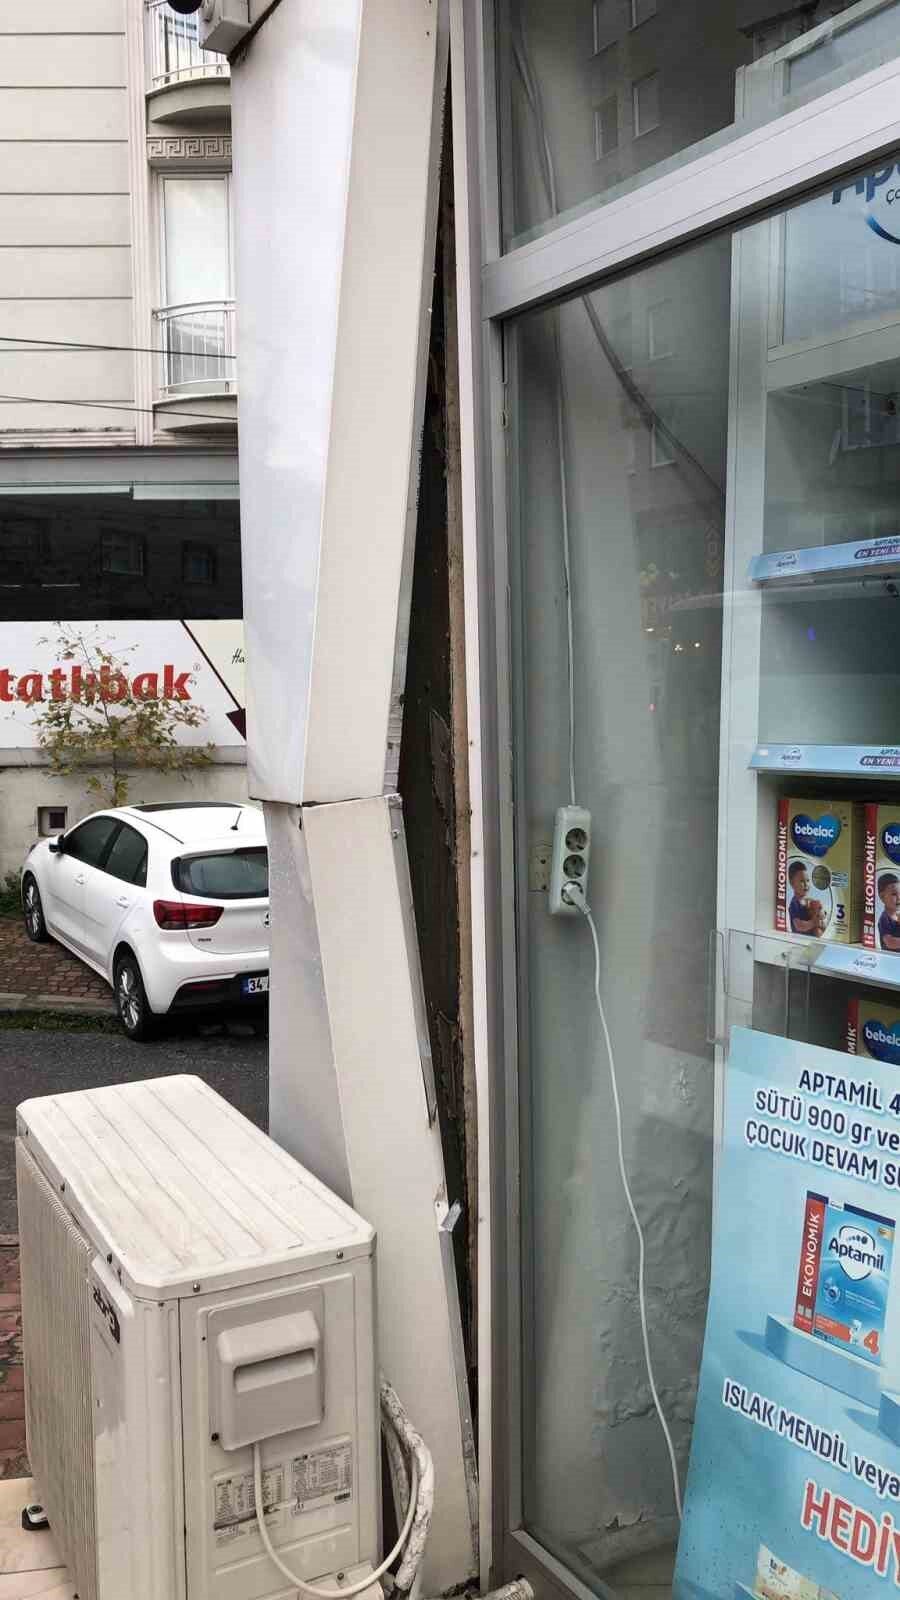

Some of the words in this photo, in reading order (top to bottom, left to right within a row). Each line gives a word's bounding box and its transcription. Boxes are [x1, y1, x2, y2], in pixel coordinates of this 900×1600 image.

[794, 822, 834, 838] bebelac
[836, 903, 845, 920] 3
[799, 1069, 882, 1110] APTAMİL
[755, 1089, 802, 1121] SÜTÜ
[808, 1105, 846, 1134] 900
[851, 1122, 873, 1144] gr
[877, 1129, 900, 1151] ve
[746, 1120, 807, 1157] ÇOCUK
[812, 1140, 878, 1180] DEVAM
[828, 1237, 885, 1272] Aptamil
[863, 1329, 880, 1354] 4
[724, 1381, 775, 1427] ISLAK
[779, 1410, 848, 1468] MENDİL
[854, 1455, 900, 1497] veya
